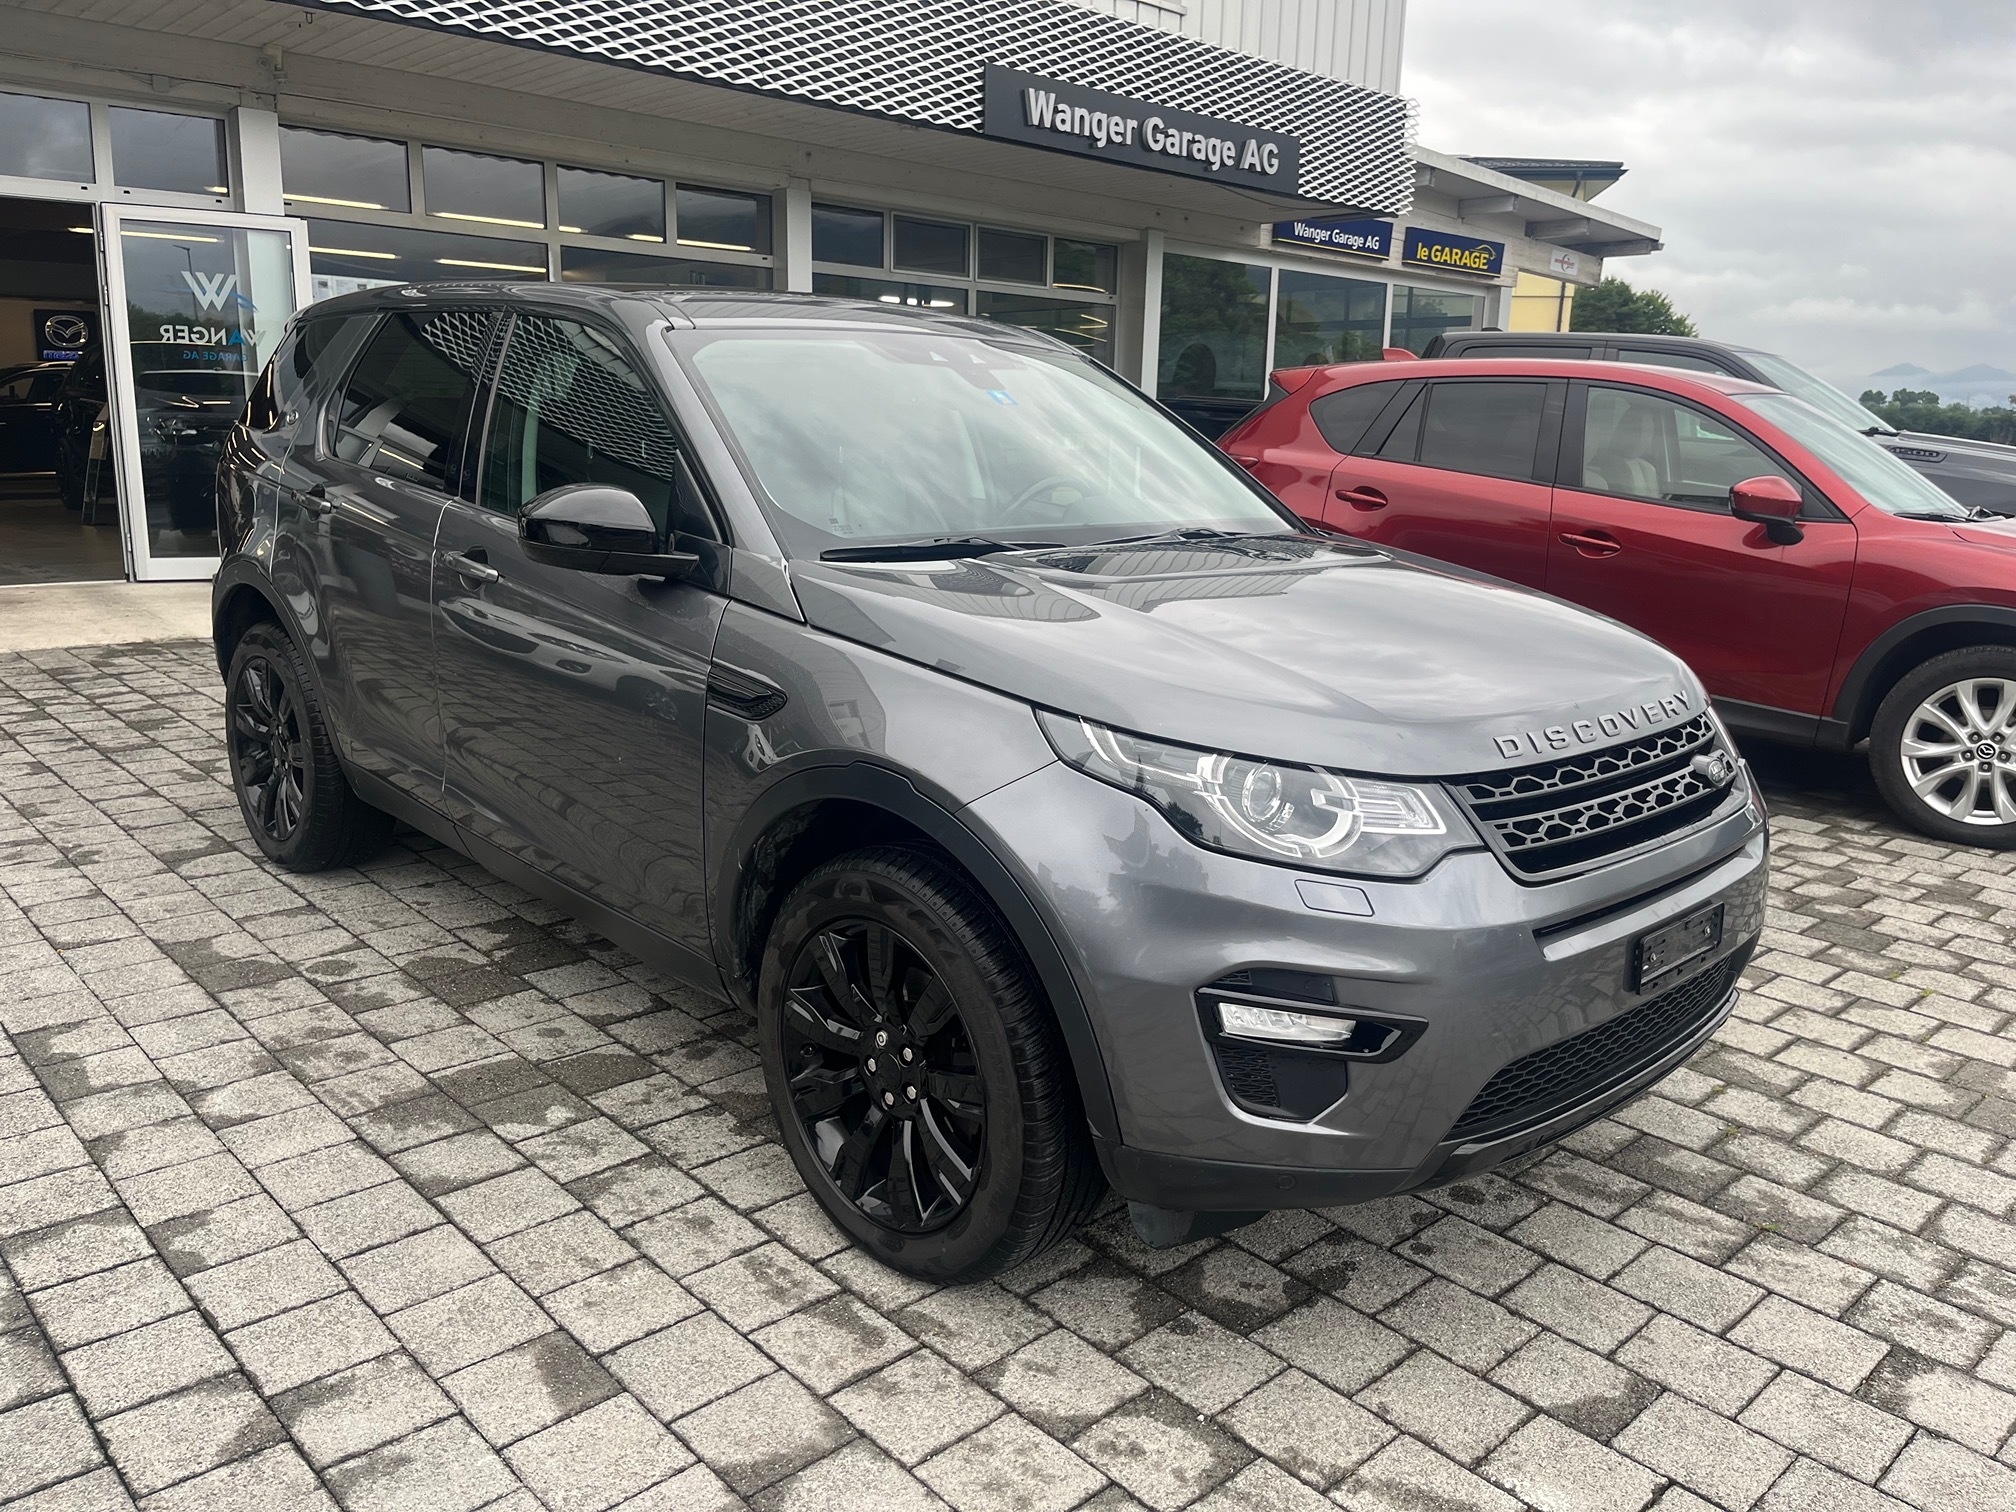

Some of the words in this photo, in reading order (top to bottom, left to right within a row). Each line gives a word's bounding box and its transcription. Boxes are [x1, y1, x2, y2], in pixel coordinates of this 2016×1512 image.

[1024, 87, 1137, 148] Wanger
[1142, 116, 1236, 171] Garage
[1239, 138, 1280, 175] AG
[1293, 222, 1331, 243] Wanger
[1332, 229, 1364, 250] Garage
[1365, 235, 1380, 250] AG
[1416, 242, 1429, 260] le
[1430, 244, 1489, 270] GARAGE
[1493, 690, 1690, 759] DISCOVERY
